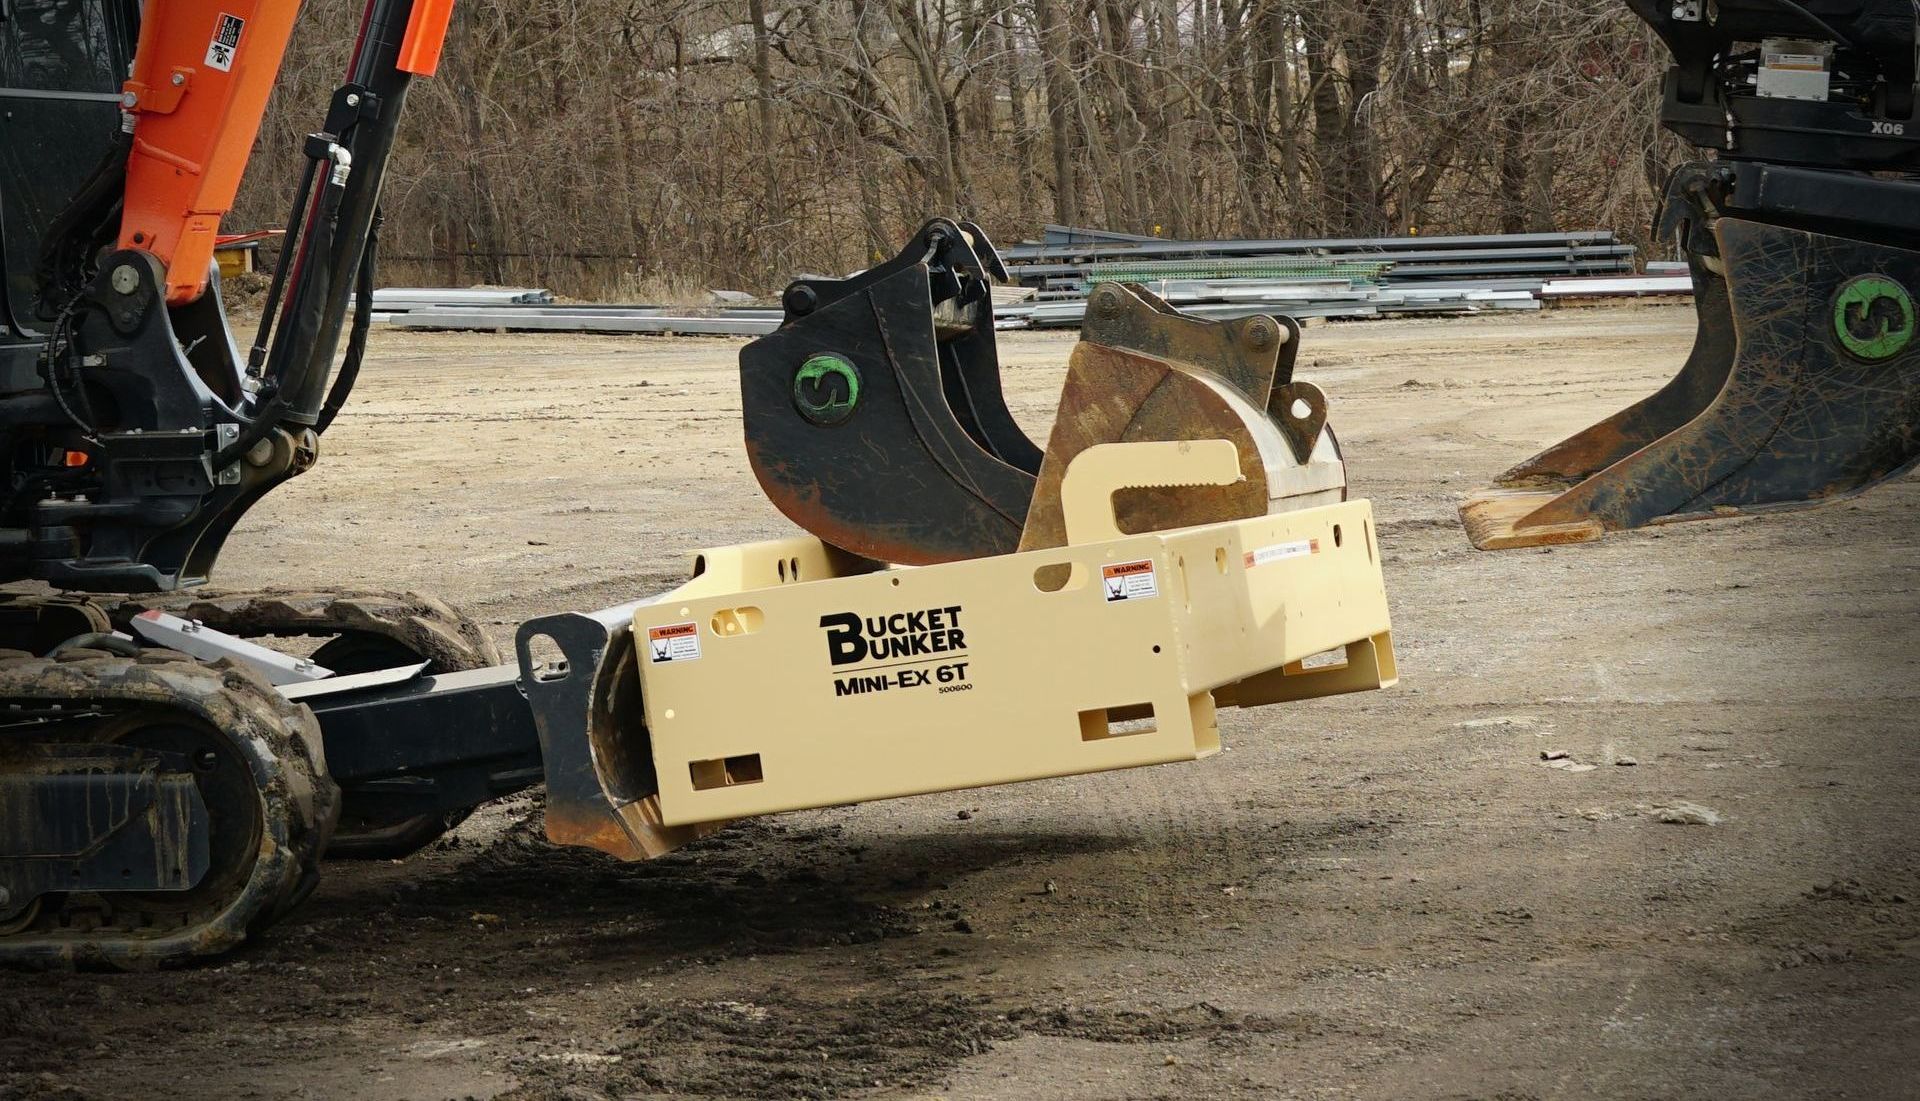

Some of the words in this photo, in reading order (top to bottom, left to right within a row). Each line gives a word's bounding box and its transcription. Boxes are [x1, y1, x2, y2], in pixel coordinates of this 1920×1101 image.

[1871, 121, 1904, 135] X06
[1113, 562, 1150, 574] WARNING
[659, 626, 694, 636] WARNING
[820, 605, 962, 665] BUCKET
[827, 629, 967, 665] BUNKER
[834, 669, 931, 696] MINI-EX
[936, 662, 969, 683] 6T
